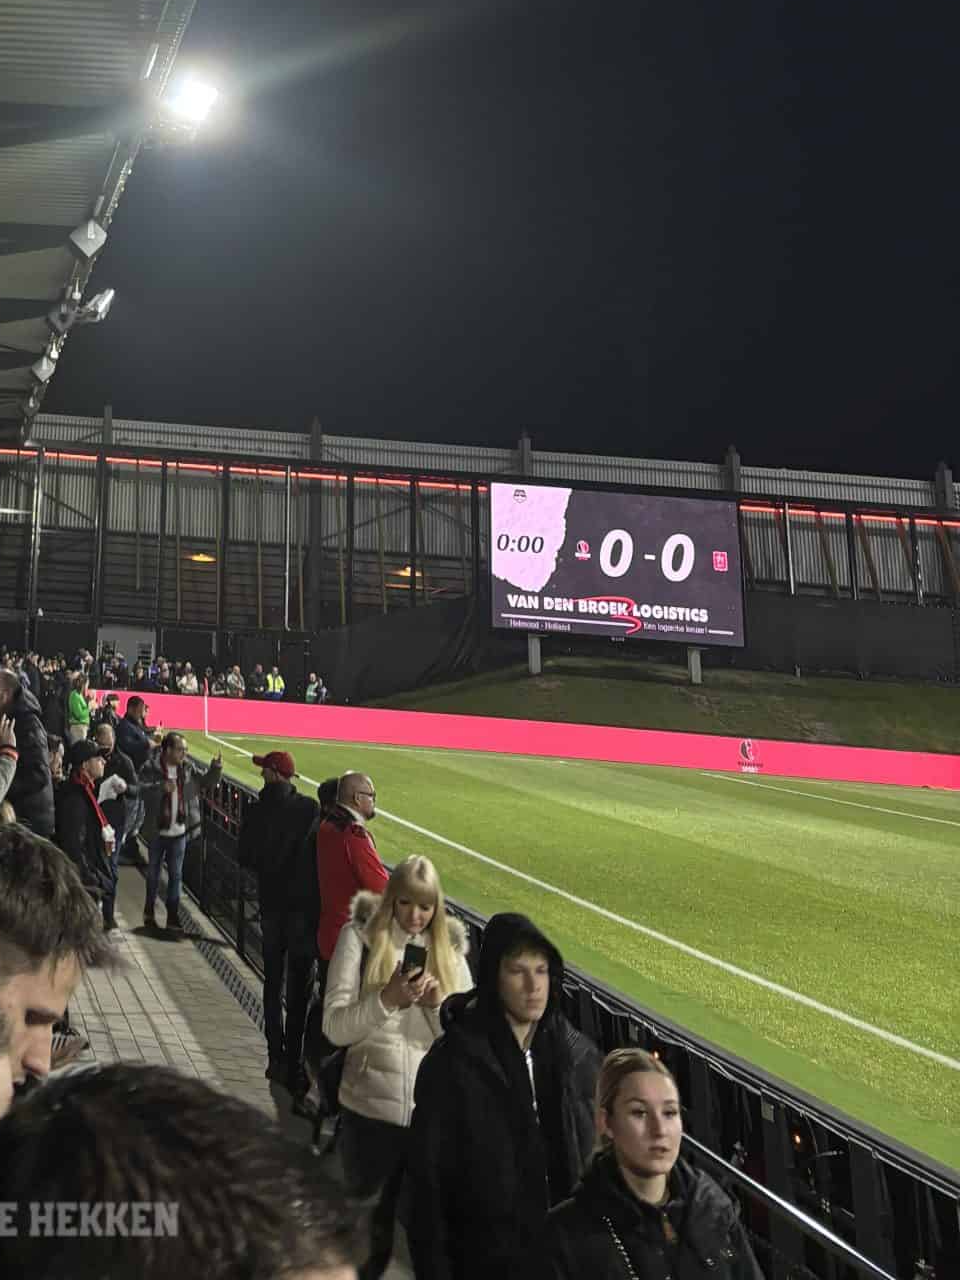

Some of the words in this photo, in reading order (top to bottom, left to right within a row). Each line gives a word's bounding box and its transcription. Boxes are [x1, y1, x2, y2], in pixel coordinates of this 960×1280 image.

[497, 533, 544, 553] 0:00
[507, 594, 539, 610] VAN
[544, 597, 575, 613] DEN
[578, 599, 629, 617] BROEK
[632, 604, 709, 623] LOGISTICS
